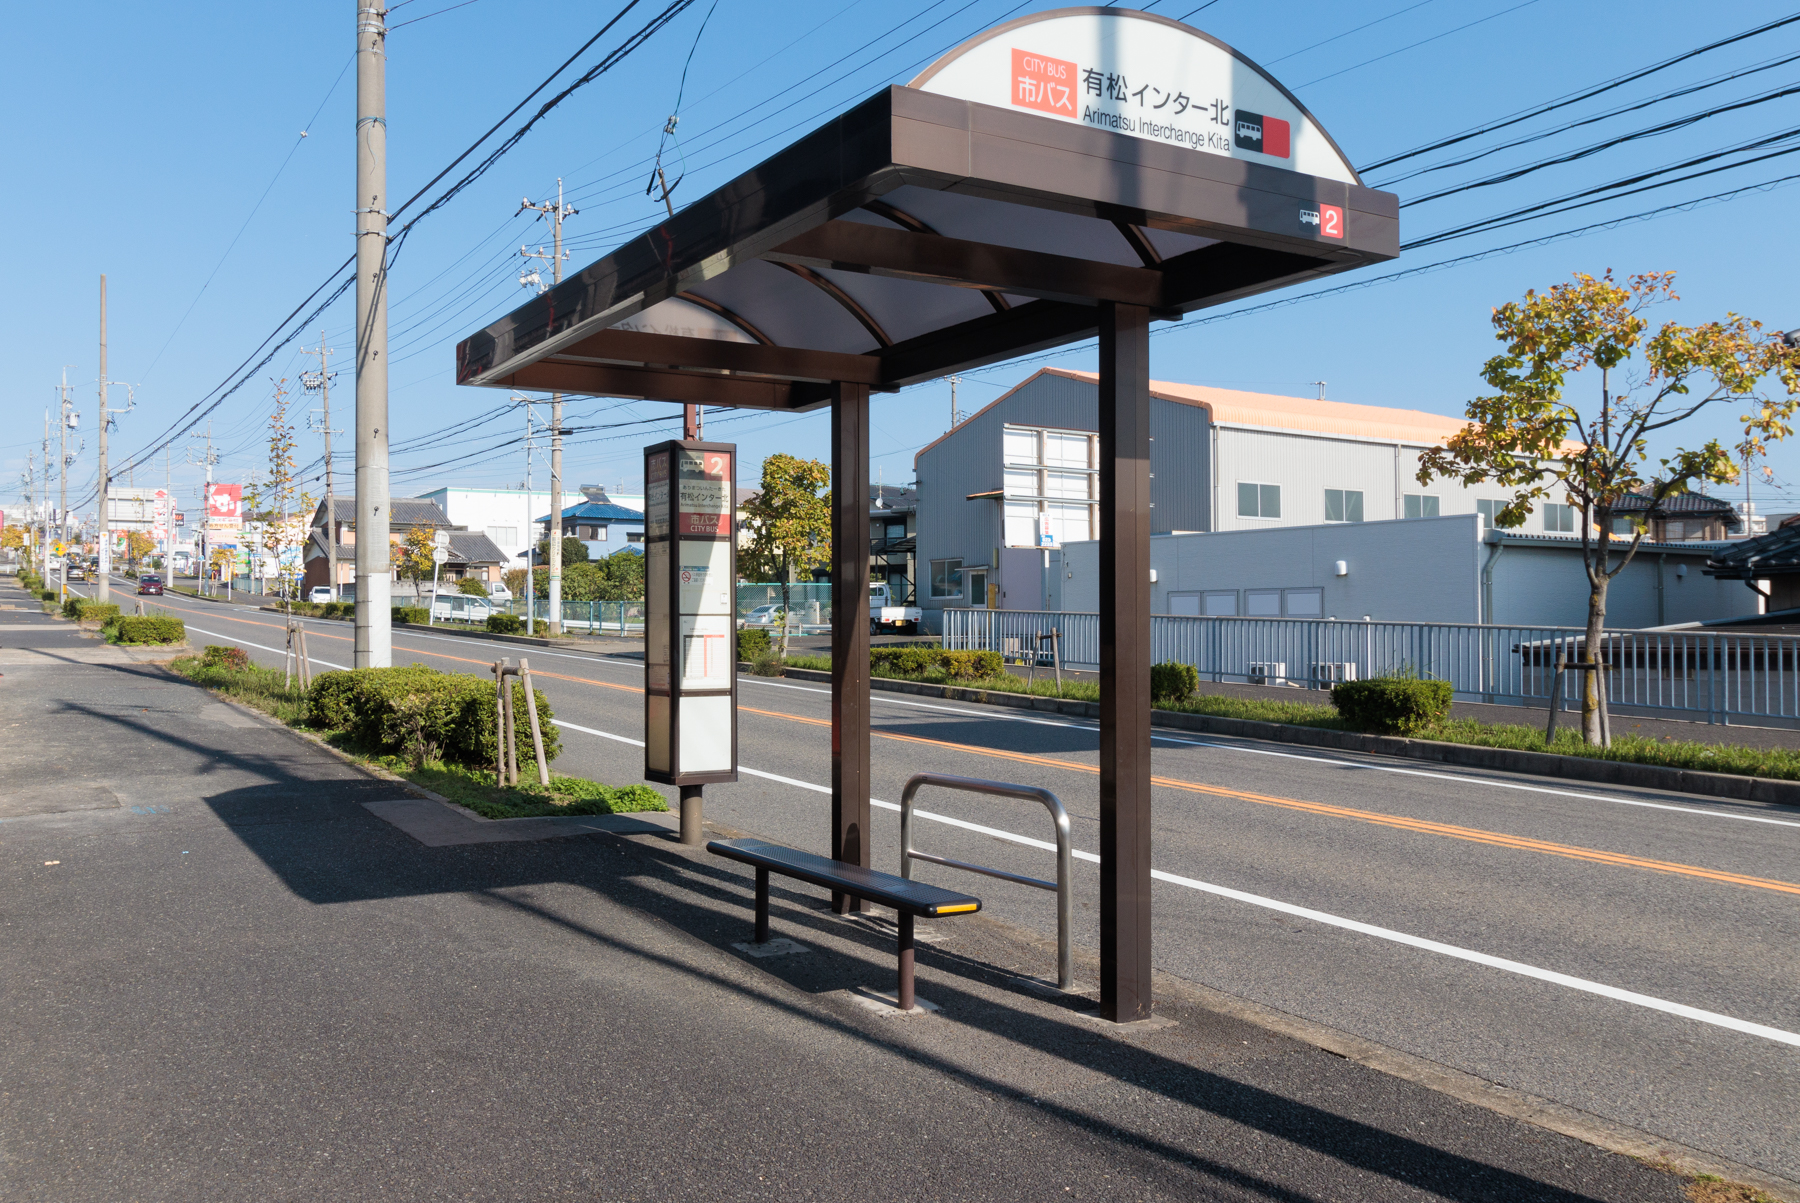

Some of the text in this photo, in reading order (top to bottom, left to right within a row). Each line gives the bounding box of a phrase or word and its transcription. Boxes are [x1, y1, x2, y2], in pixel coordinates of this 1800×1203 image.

[1023, 57, 1066, 79] CITY BUS
[1017, 75, 1072, 111] 市バス
[1082, 67, 1230, 126] 有松インター北
[1082, 104, 1230, 152] Arimatsu Interchange Kita
[1325, 210, 1338, 234] 2
[711, 457, 723, 476] 2
[680, 492, 729, 503] 有松インター北
[690, 514, 719, 525] 市バス
